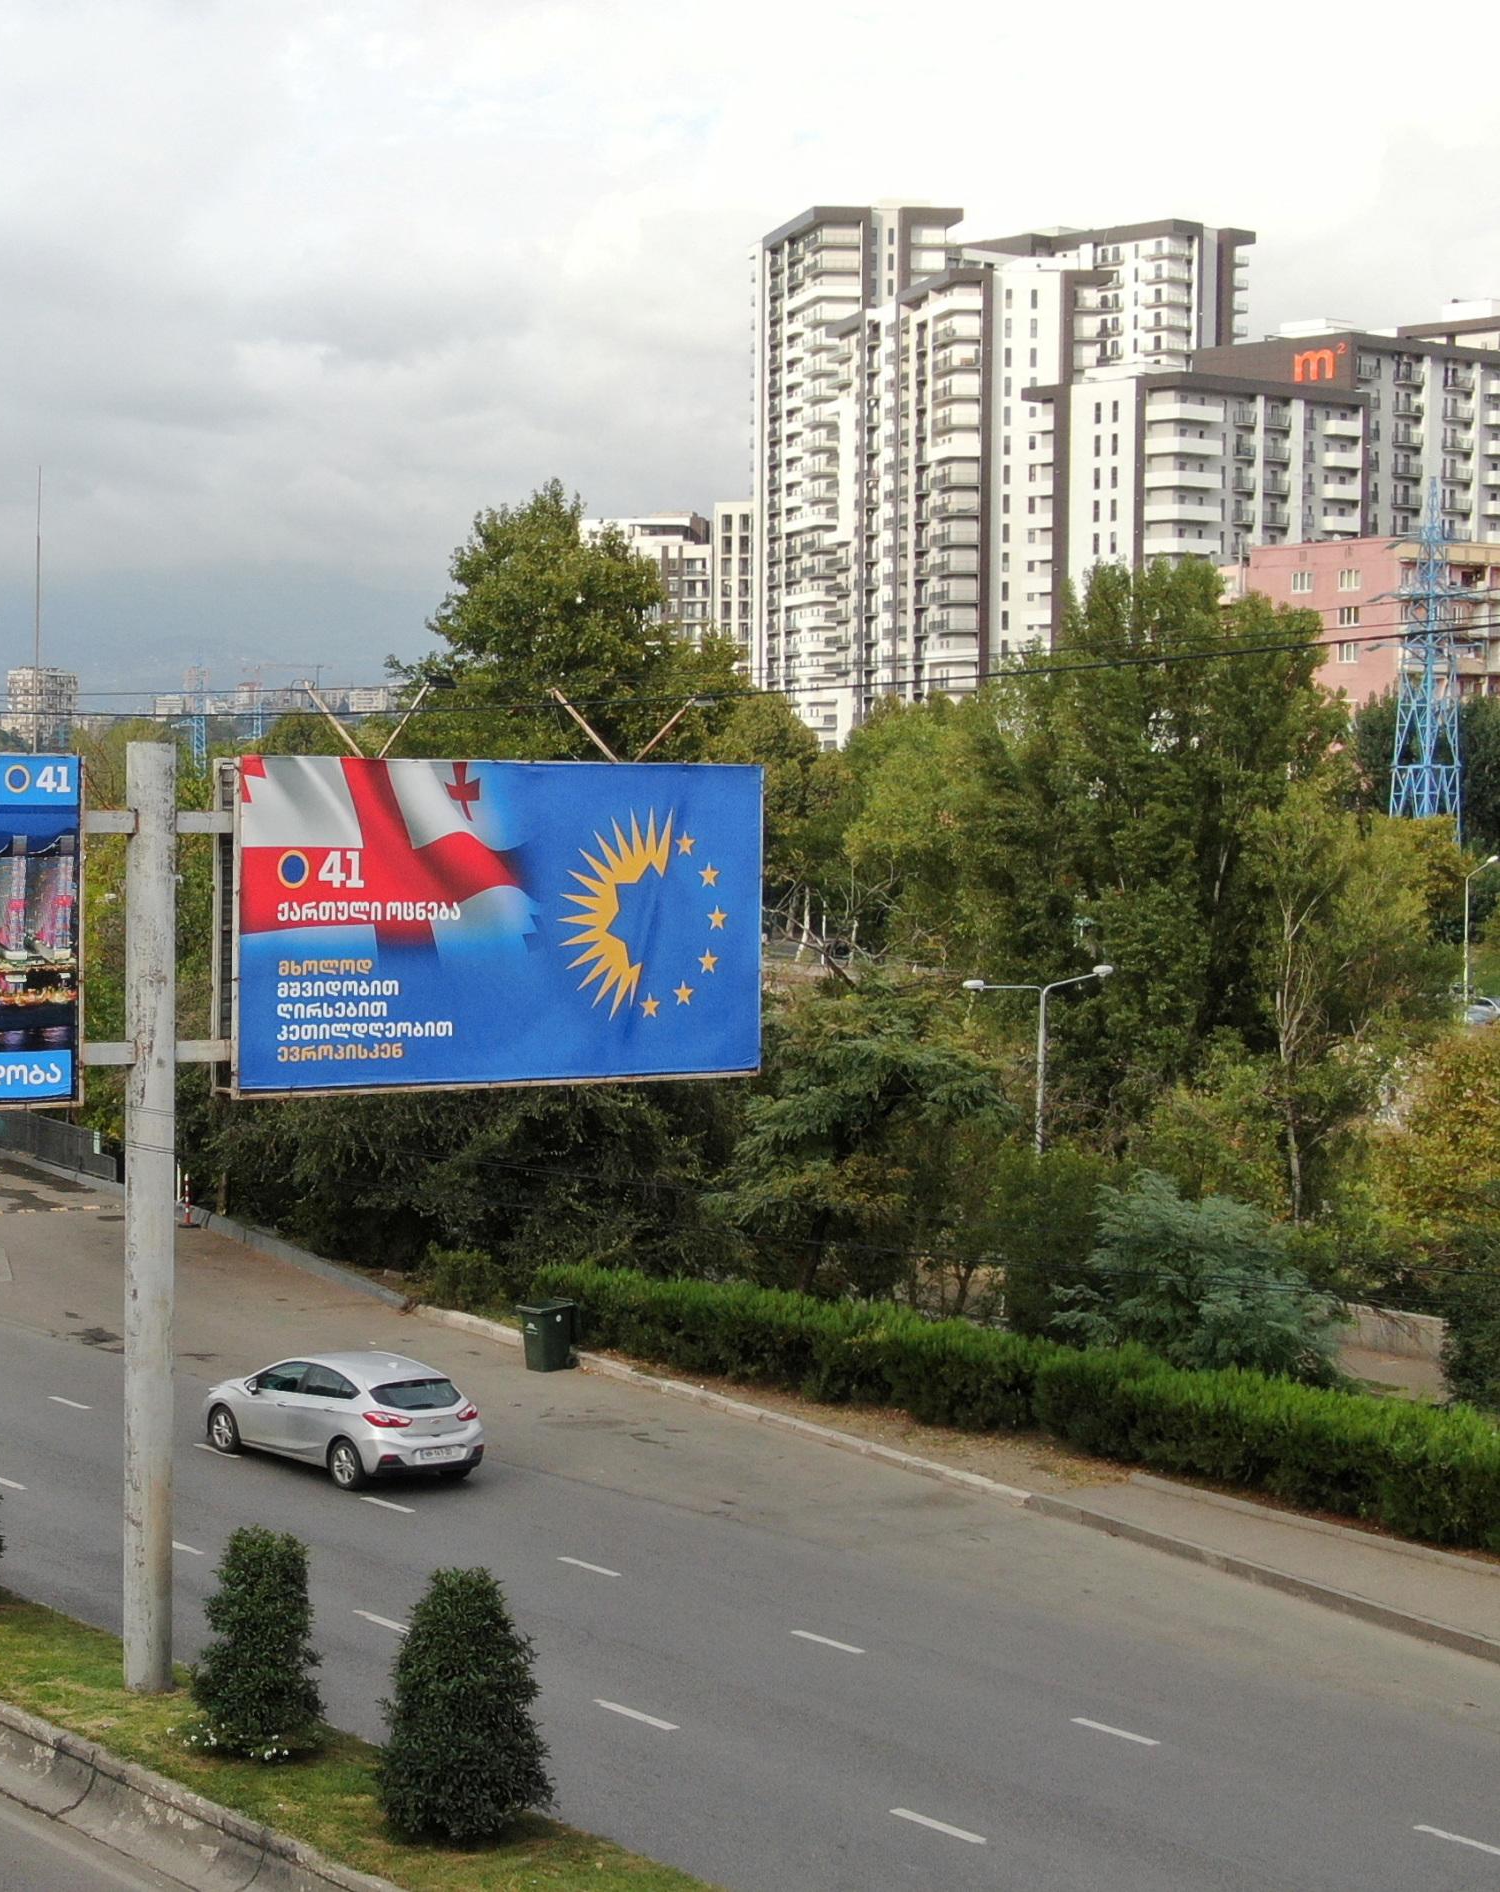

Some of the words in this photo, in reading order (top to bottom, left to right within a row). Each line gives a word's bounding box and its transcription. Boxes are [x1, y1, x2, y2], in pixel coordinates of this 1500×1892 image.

[35, 766, 71, 793] 41
[318, 850, 365, 888] 41
[277, 901, 381, 921] ქართული
[386, 901, 461, 921] ოცნება
[278, 959, 373, 976] მხოლოდ
[277, 980, 399, 998] მშვიდობით
[276, 1001, 388, 1019] ღირსებით
[276, 1021, 453, 1041] კეთილდღეობით
[277, 1043, 404, 1062] ევროპისკენ
